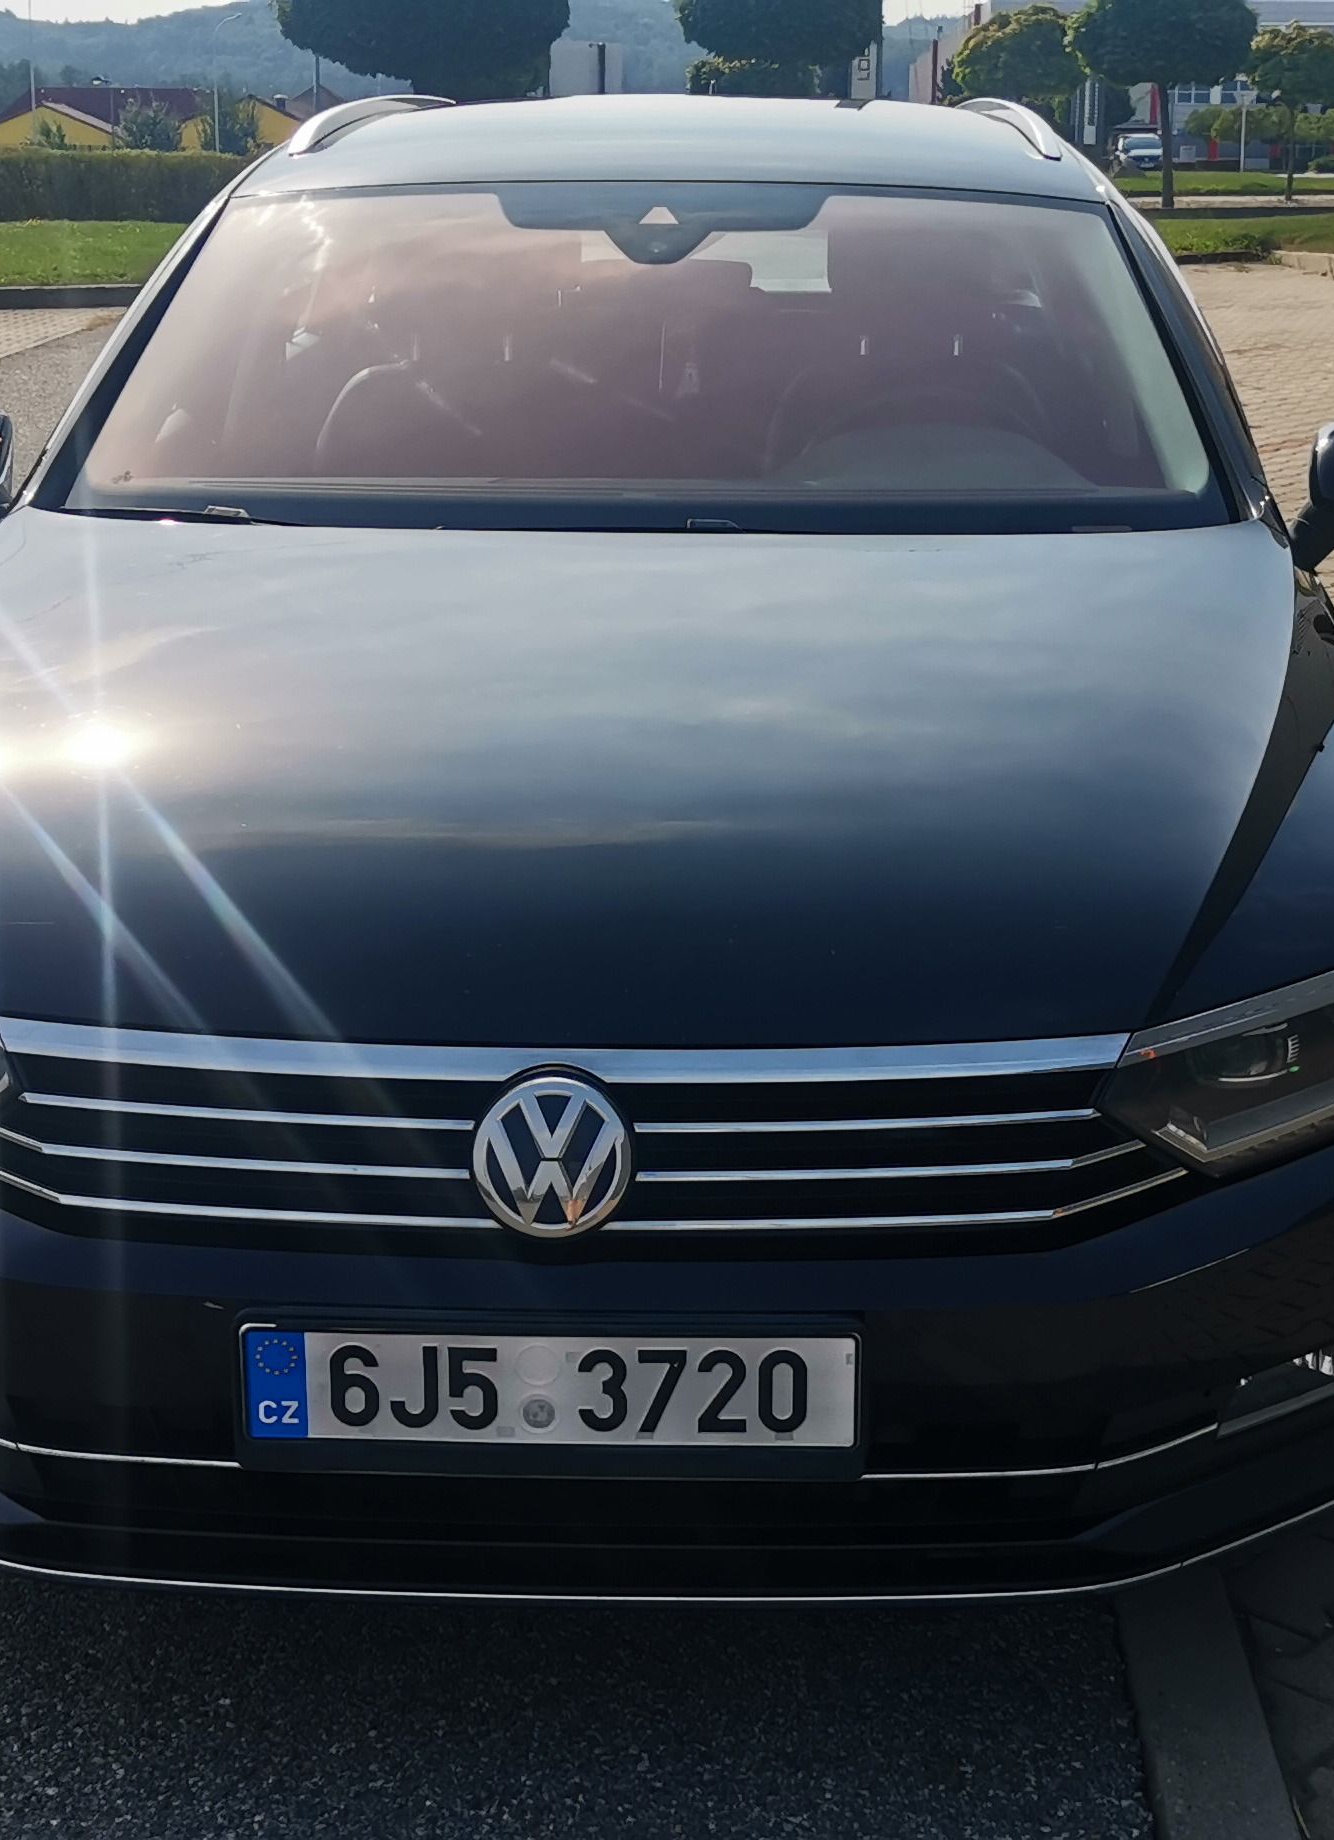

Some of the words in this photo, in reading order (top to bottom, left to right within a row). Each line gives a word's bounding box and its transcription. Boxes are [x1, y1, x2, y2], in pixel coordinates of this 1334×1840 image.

[474, 1078, 631, 1238] VW
[258, 1400, 300, 1424] CZ
[329, 1344, 499, 1430] 6J5
[577, 1349, 808, 1434] 3720
